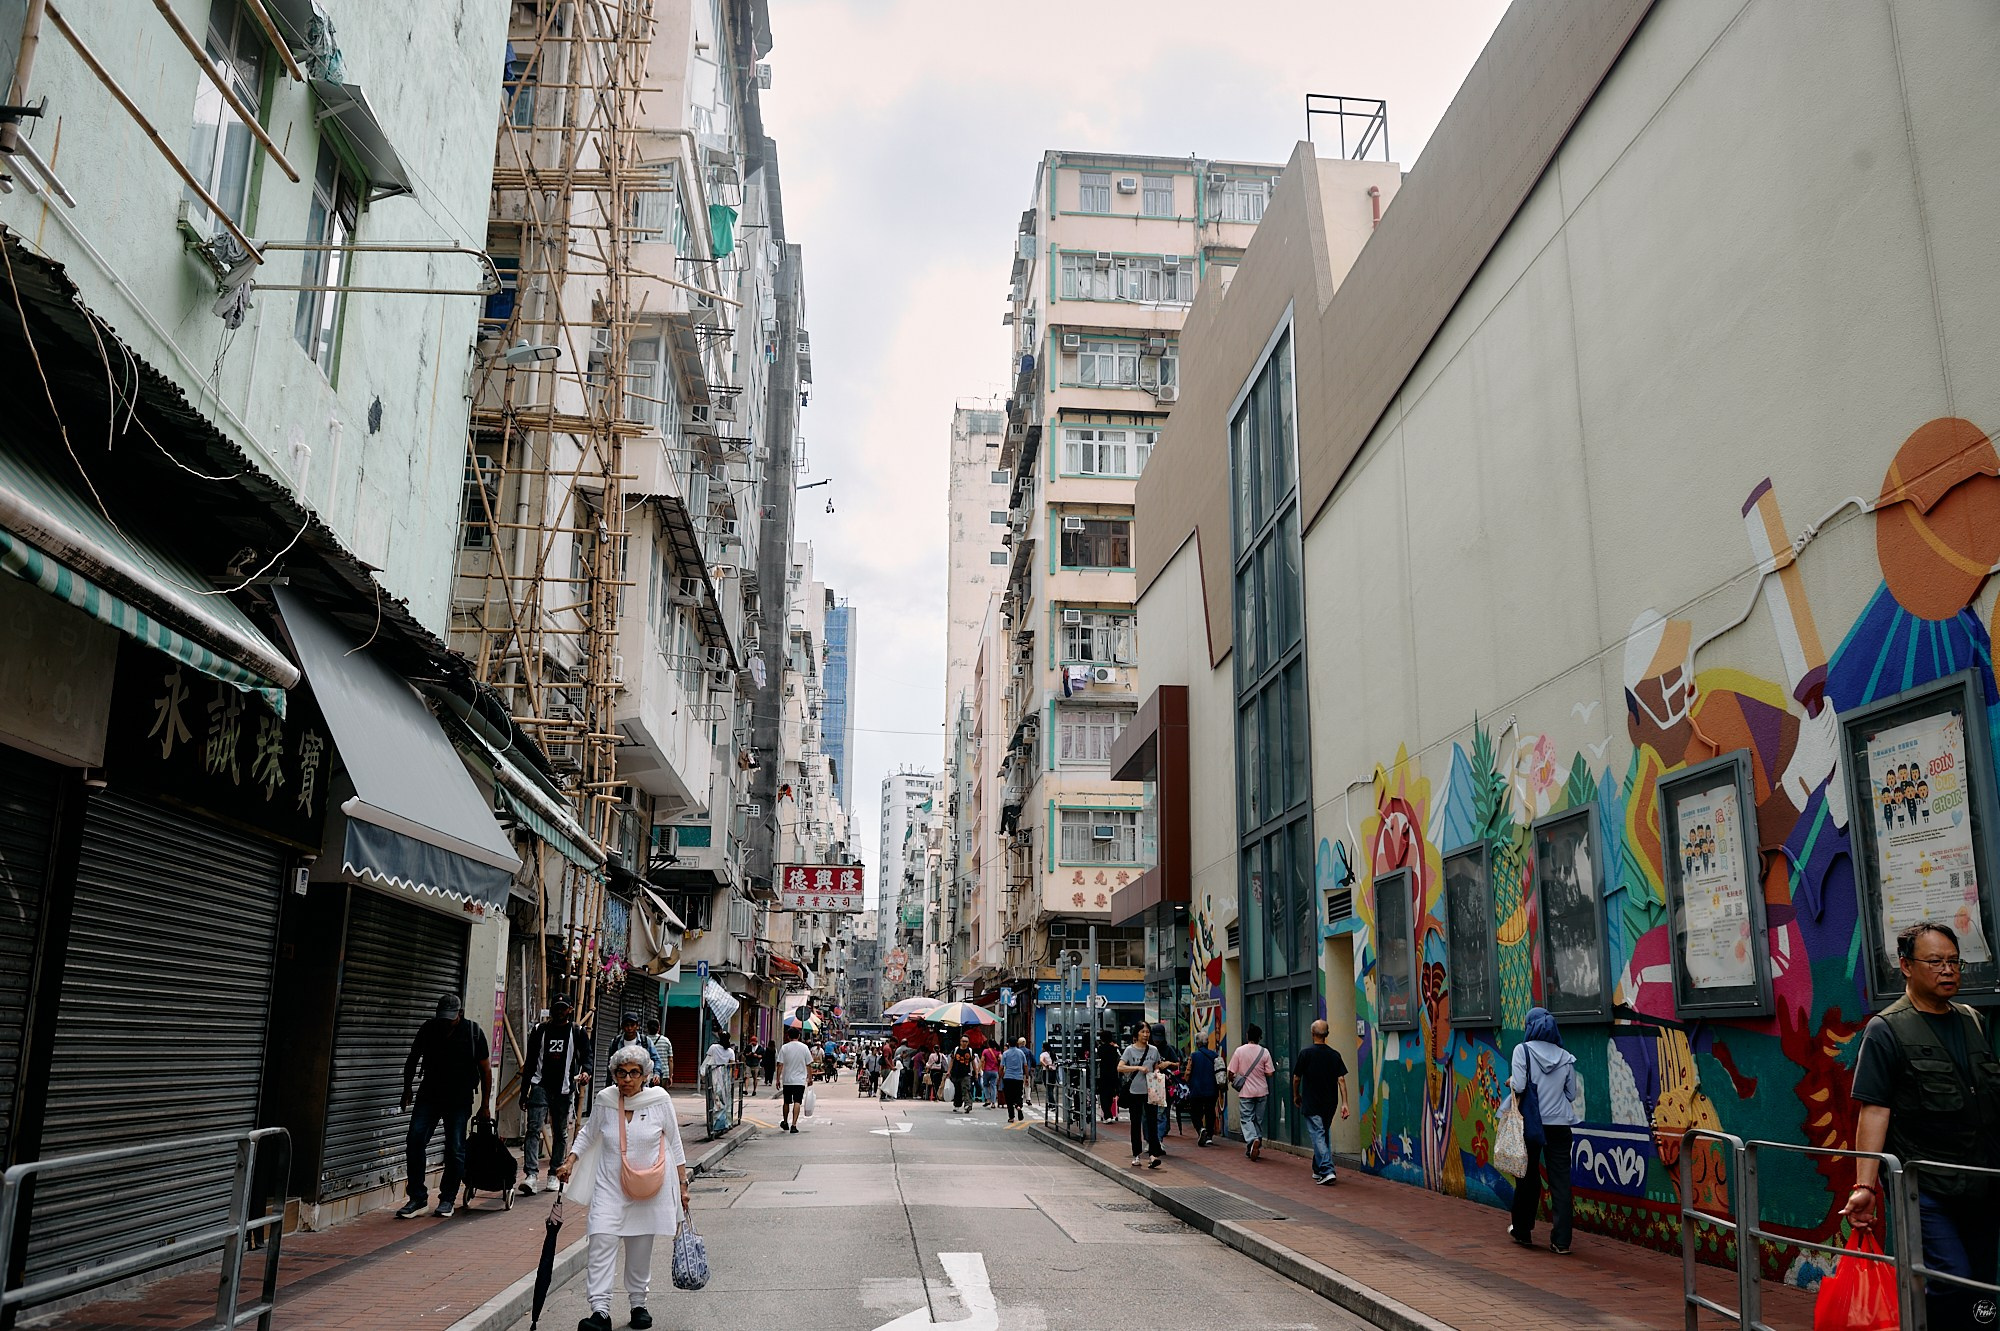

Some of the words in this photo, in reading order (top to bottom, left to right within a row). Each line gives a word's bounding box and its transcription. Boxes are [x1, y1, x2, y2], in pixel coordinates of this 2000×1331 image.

[1929, 752, 1954, 776] JOIN
[1933, 773, 1956, 791] OUR
[1932, 788, 1963, 815] CHOIR
[789, 868, 859, 891] 德興隆
[796, 895, 850, 907] 藥業公司
[549, 1039, 564, 1053] 23
